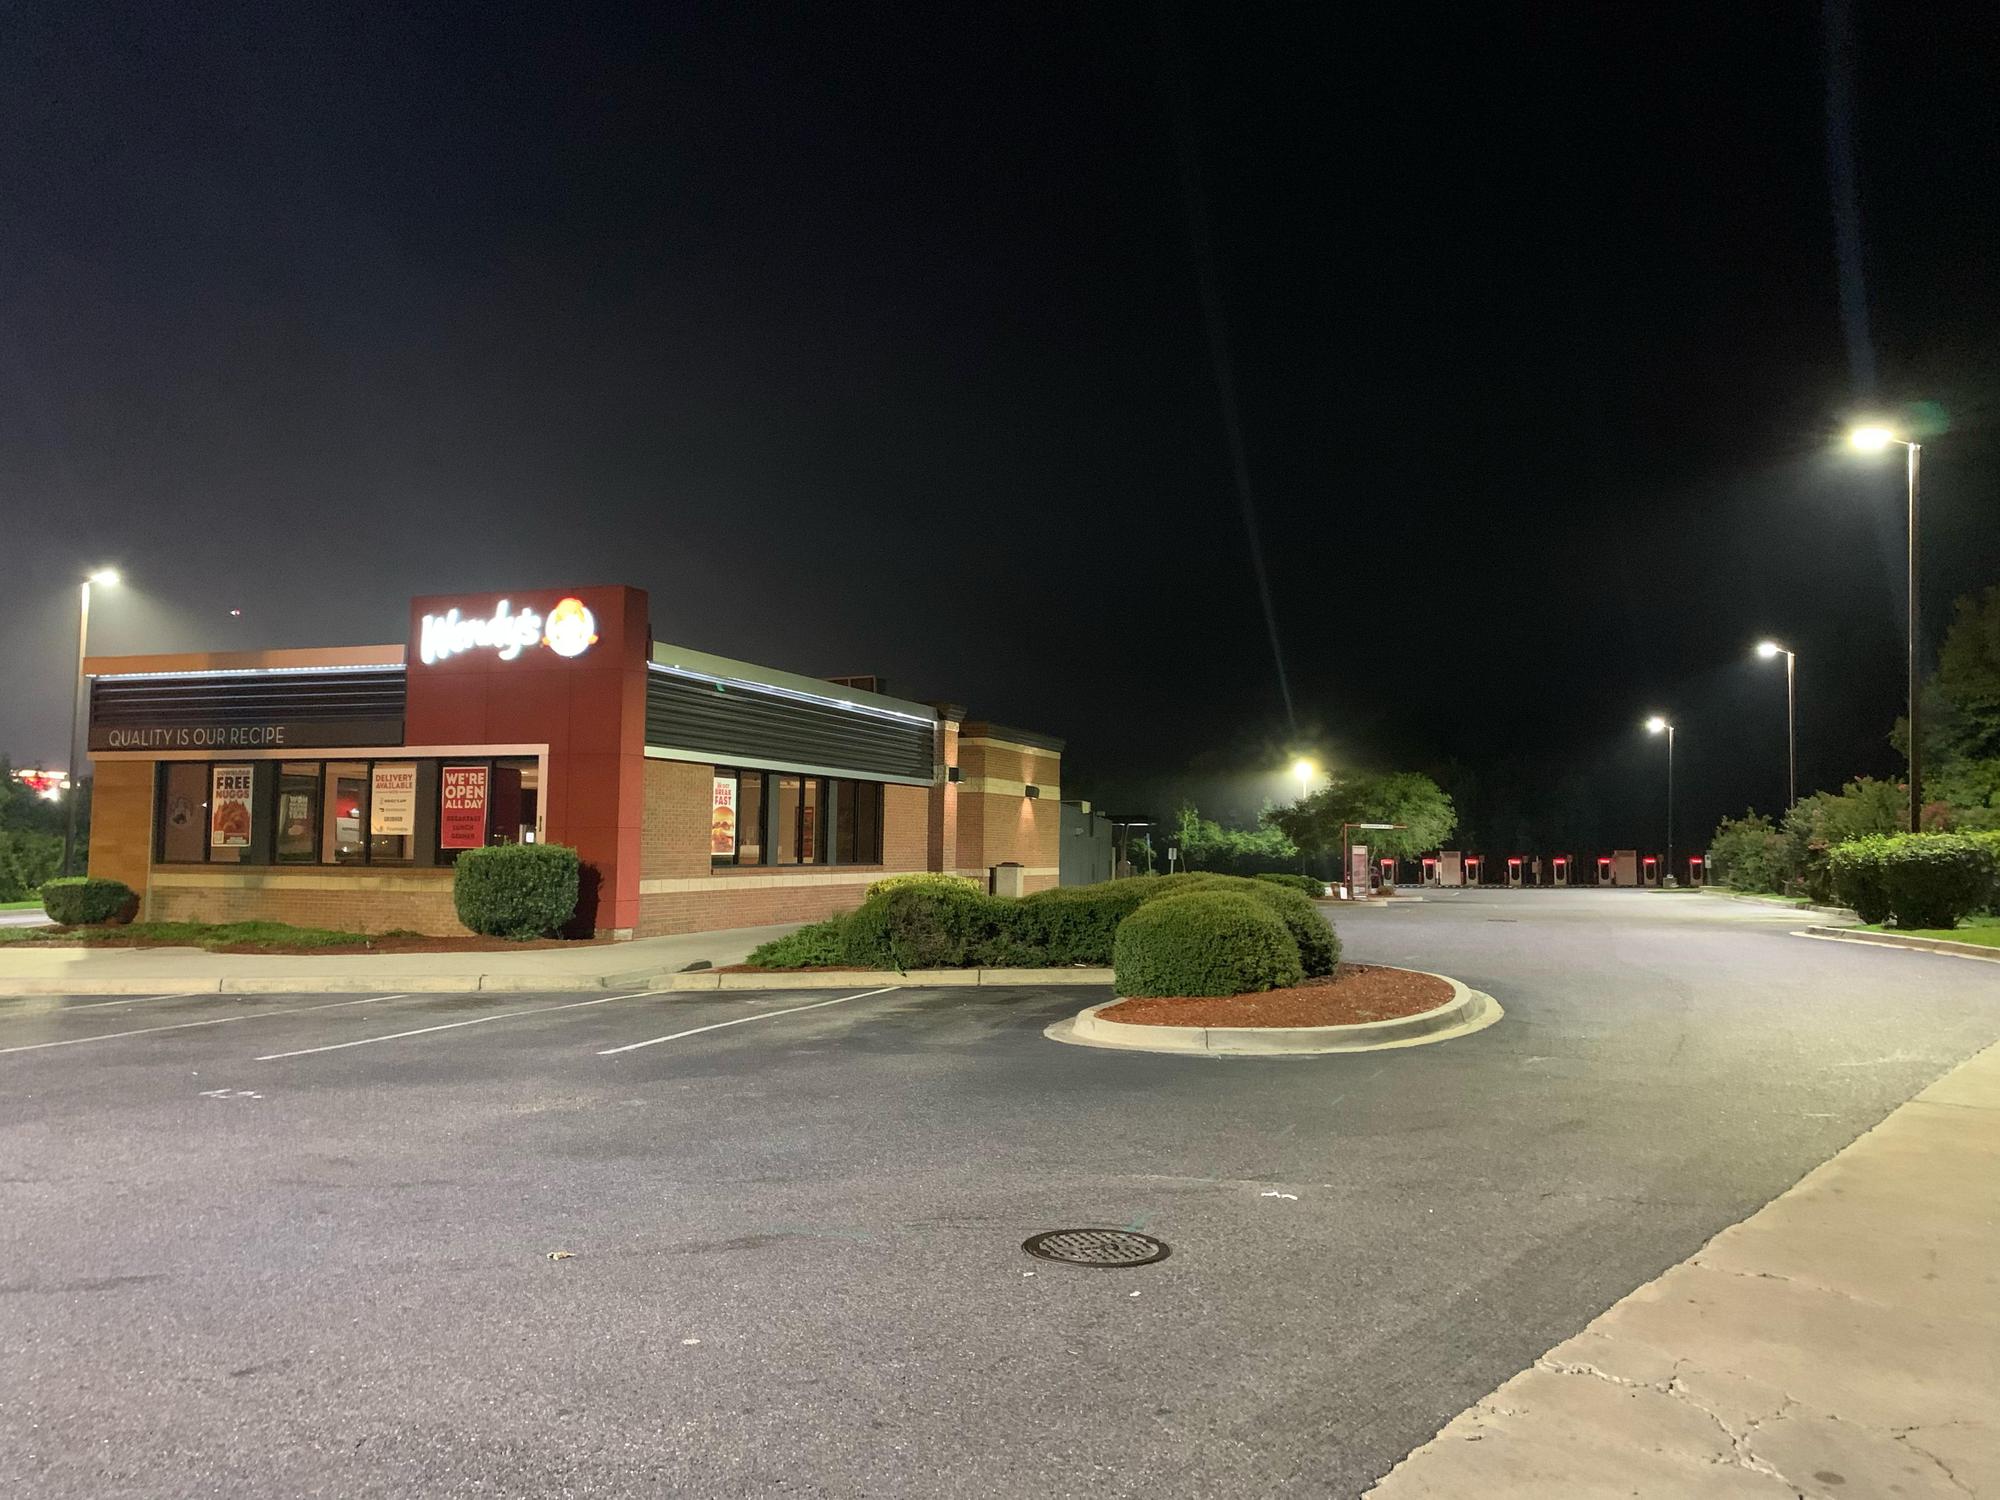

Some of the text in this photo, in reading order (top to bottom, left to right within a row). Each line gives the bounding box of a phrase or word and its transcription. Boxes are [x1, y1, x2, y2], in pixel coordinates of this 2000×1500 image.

[420, 599, 541, 664] Wendy's
[109, 726, 285, 747] QUALITY IS OUR RECIPE
[217, 776, 250, 789] FREE
[375, 774, 413, 782] DELIVERY
[445, 773, 485, 785] WE'RE
[216, 790, 250, 798] NUGGS
[445, 785, 484, 799] OPEN
[445, 799, 483, 809] ALL DAY
[715, 796, 732, 805] FAST
